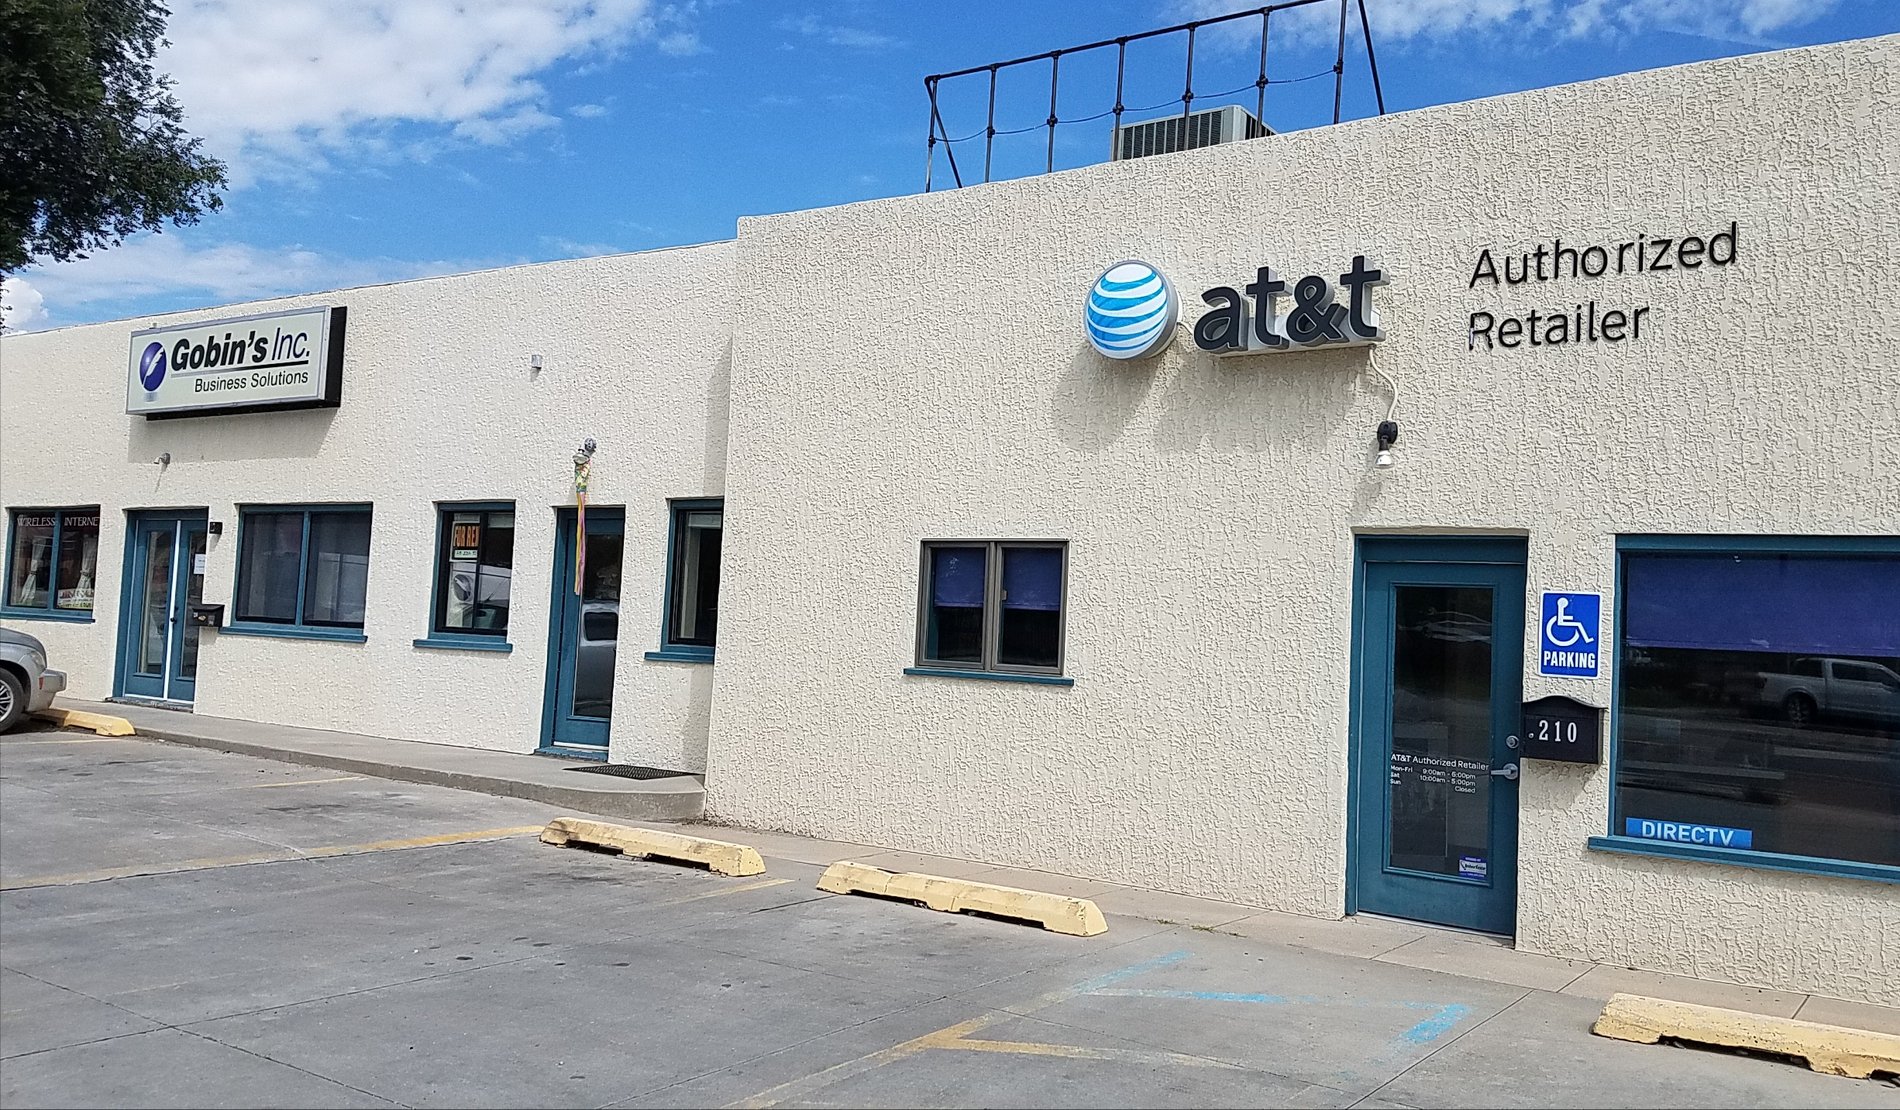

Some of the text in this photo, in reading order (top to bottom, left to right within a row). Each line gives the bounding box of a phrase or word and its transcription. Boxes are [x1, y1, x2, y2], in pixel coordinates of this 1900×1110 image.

[1469, 221, 1737, 288] Authorized
[1193, 255, 1385, 351] at&t
[1469, 301, 1650, 350] Retailer
[171, 327, 310, 371] Gobin's Inc.
[194, 370, 308, 392] Business Solutions
[17, 517, 55, 527] WIRELESS
[1543, 651, 1596, 669] PARKING
[1538, 719, 1577, 743] 210
[1391, 754, 1489, 771] AT&T Authorized Retailer
[1642, 820, 1734, 846] DIRECTV
